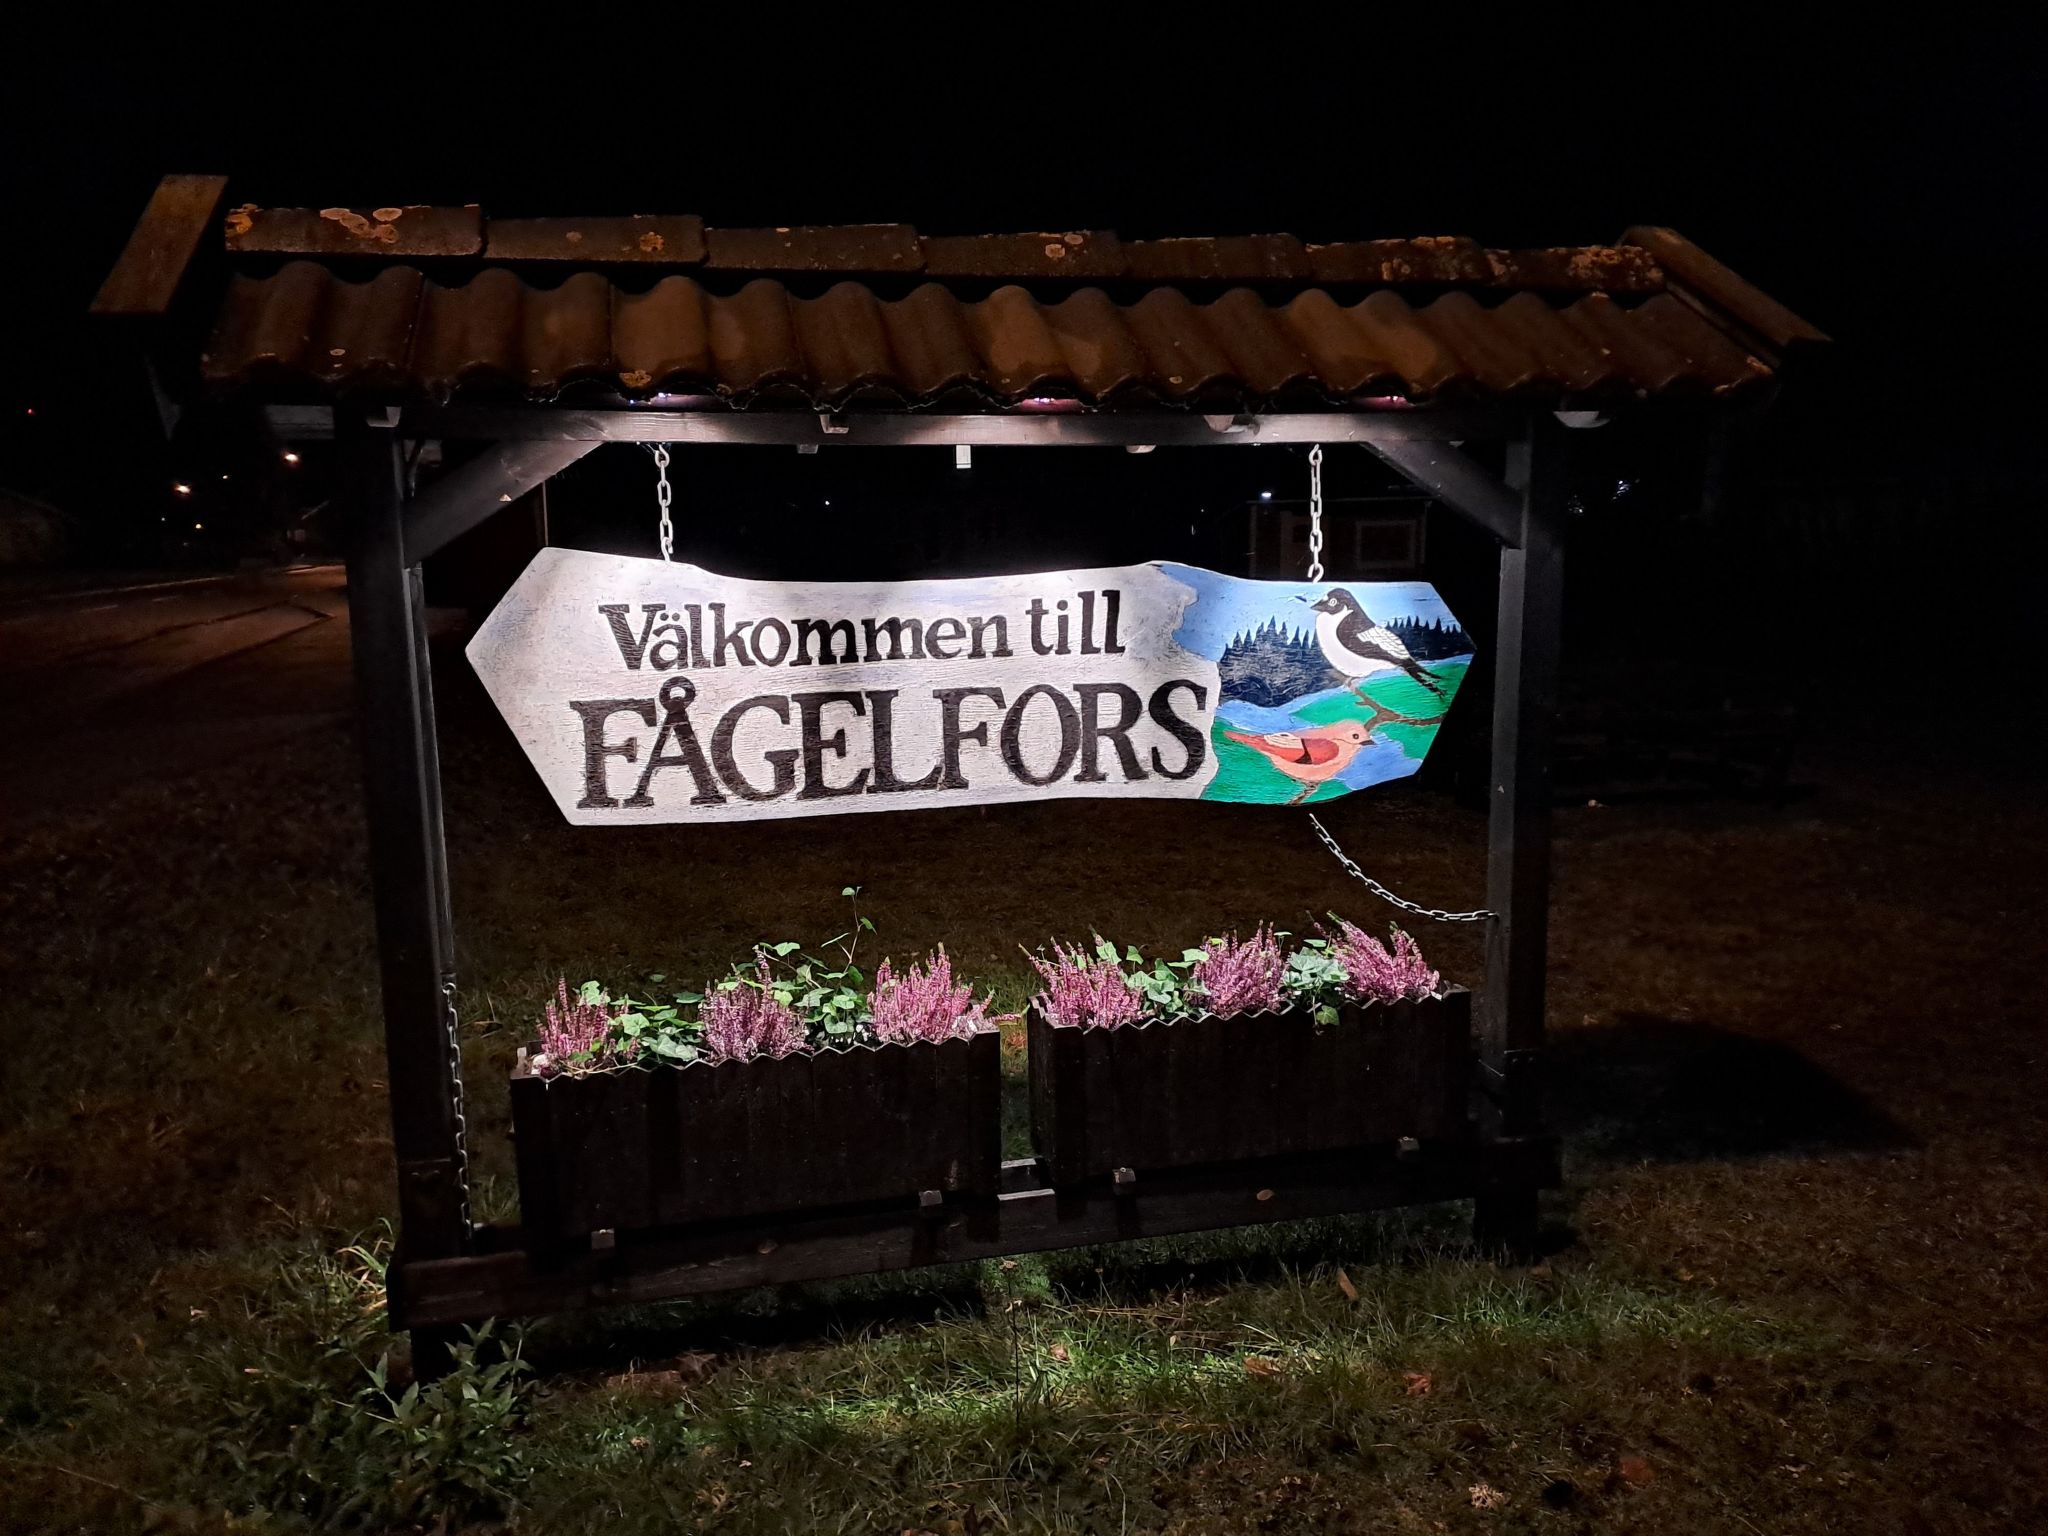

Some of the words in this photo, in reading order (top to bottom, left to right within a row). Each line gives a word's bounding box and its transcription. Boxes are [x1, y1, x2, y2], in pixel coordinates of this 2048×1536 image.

[598, 603, 1012, 670] Välkommen
[1026, 589, 1125, 655] till
[570, 676, 1206, 809] FÅGELFORS
